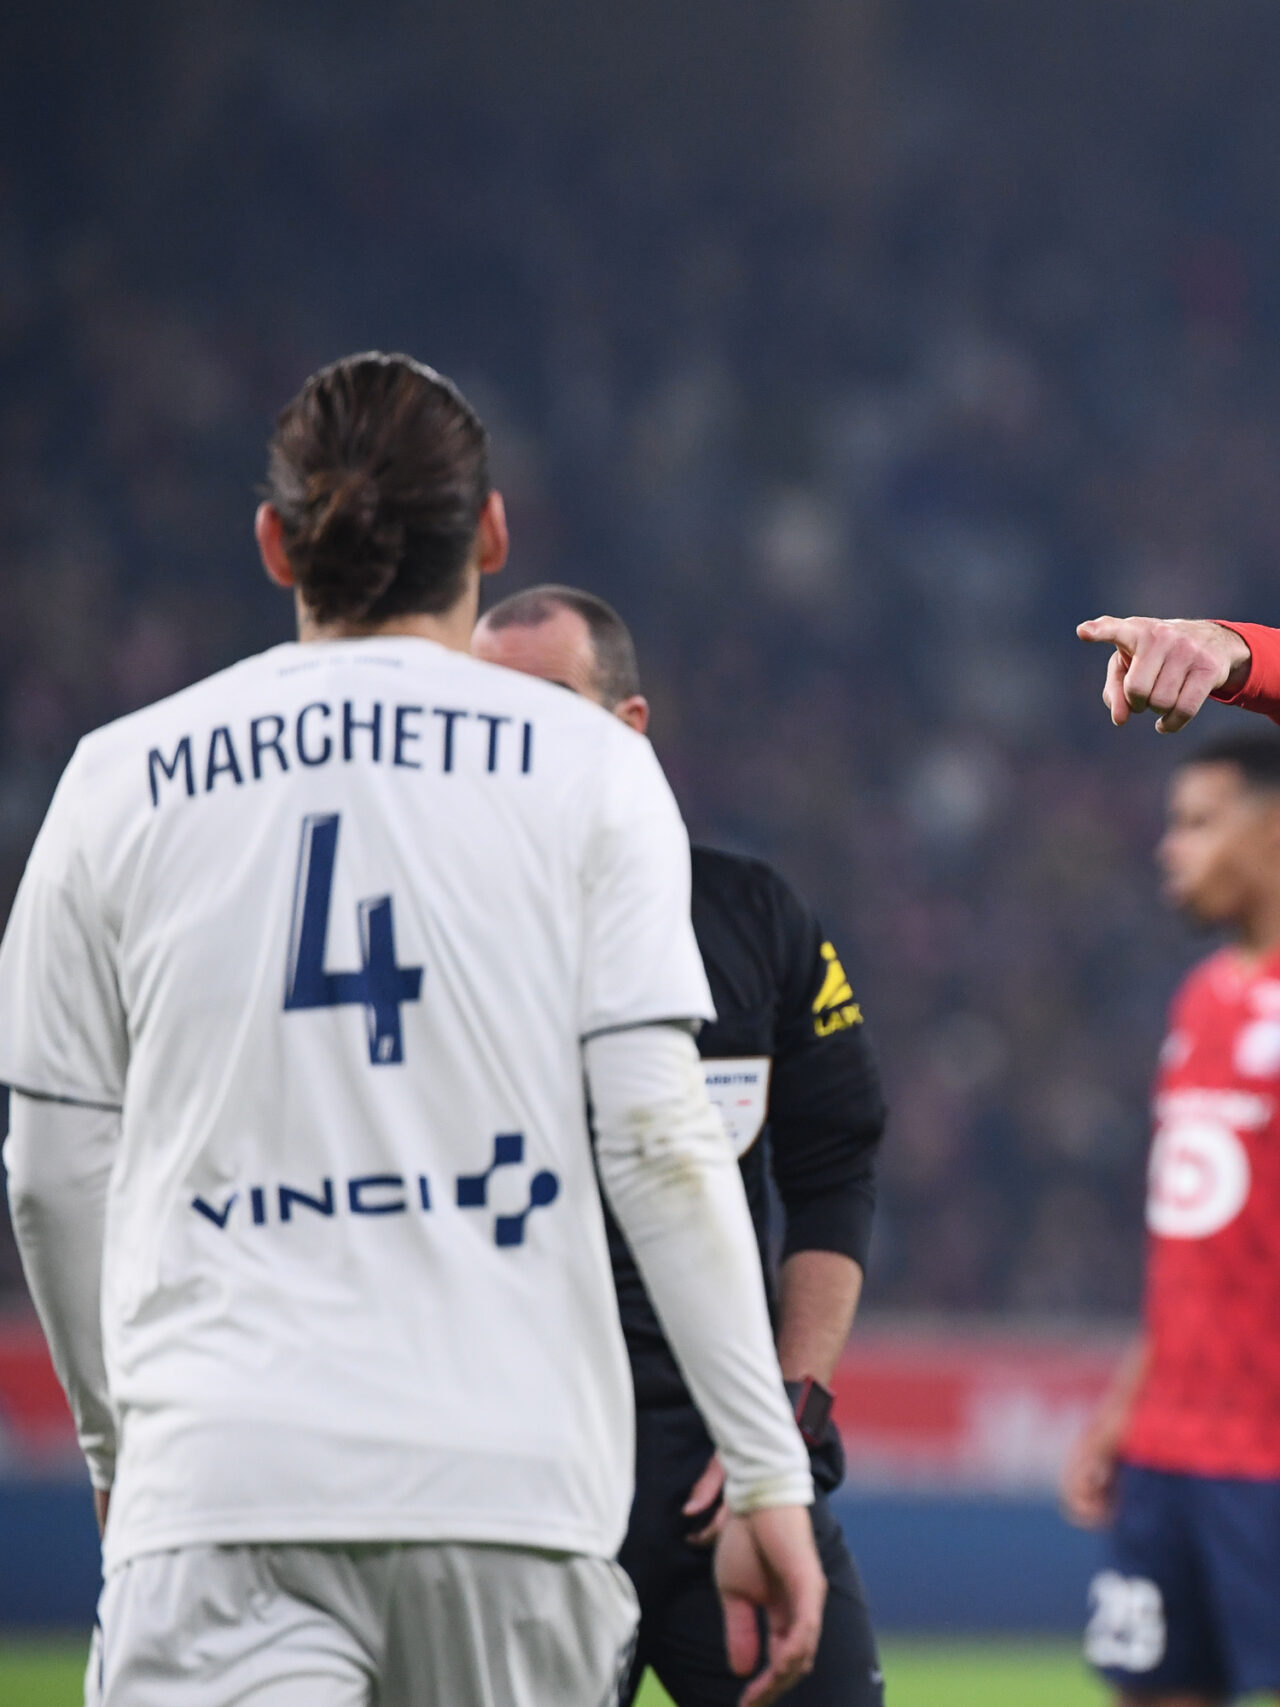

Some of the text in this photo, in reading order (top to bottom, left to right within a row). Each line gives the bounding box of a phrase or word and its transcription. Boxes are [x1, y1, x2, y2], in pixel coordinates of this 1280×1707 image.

[147, 699, 534, 808] MARCHETTI
[283, 811, 424, 1066] 4
[191, 1173, 433, 1230] VINCI
